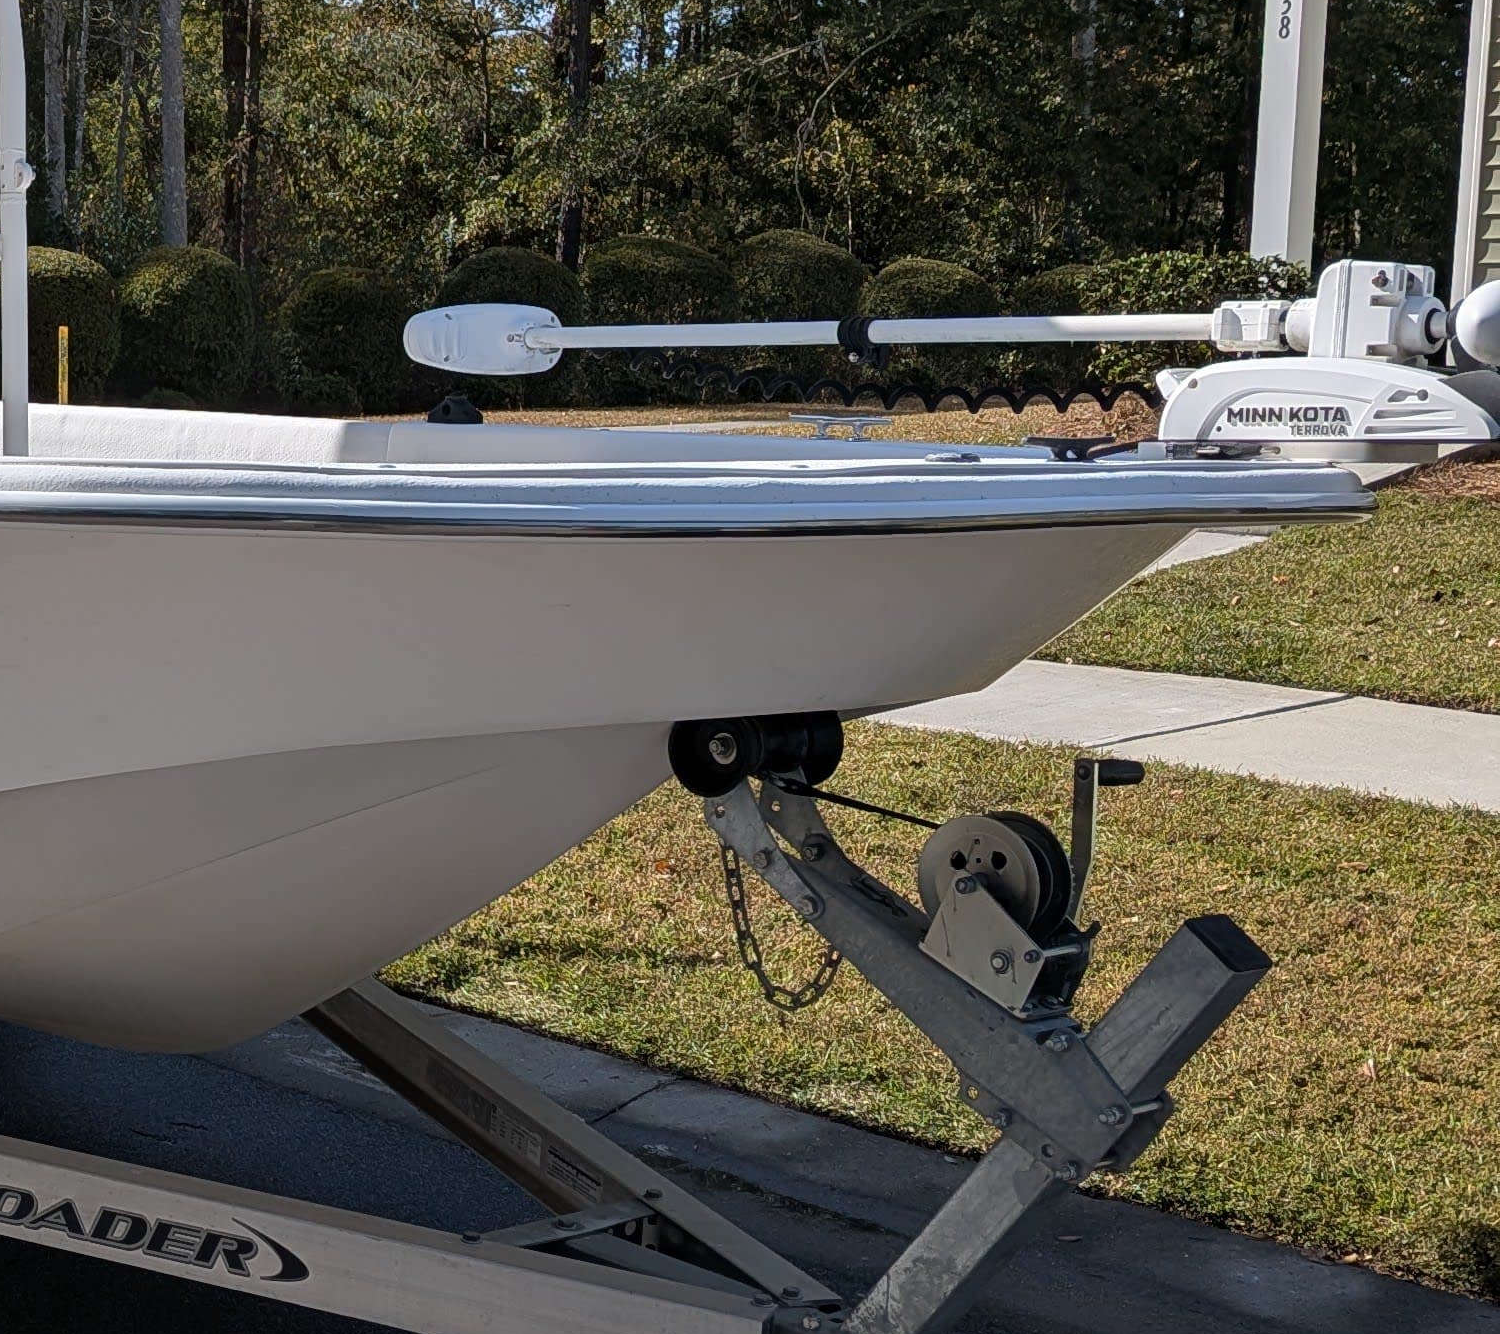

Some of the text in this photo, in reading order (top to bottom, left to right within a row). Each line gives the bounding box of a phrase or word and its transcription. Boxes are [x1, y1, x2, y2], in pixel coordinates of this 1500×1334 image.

[1227, 406, 1346, 423] MINN KOTA
[1289, 424, 1348, 436] TERROVA
